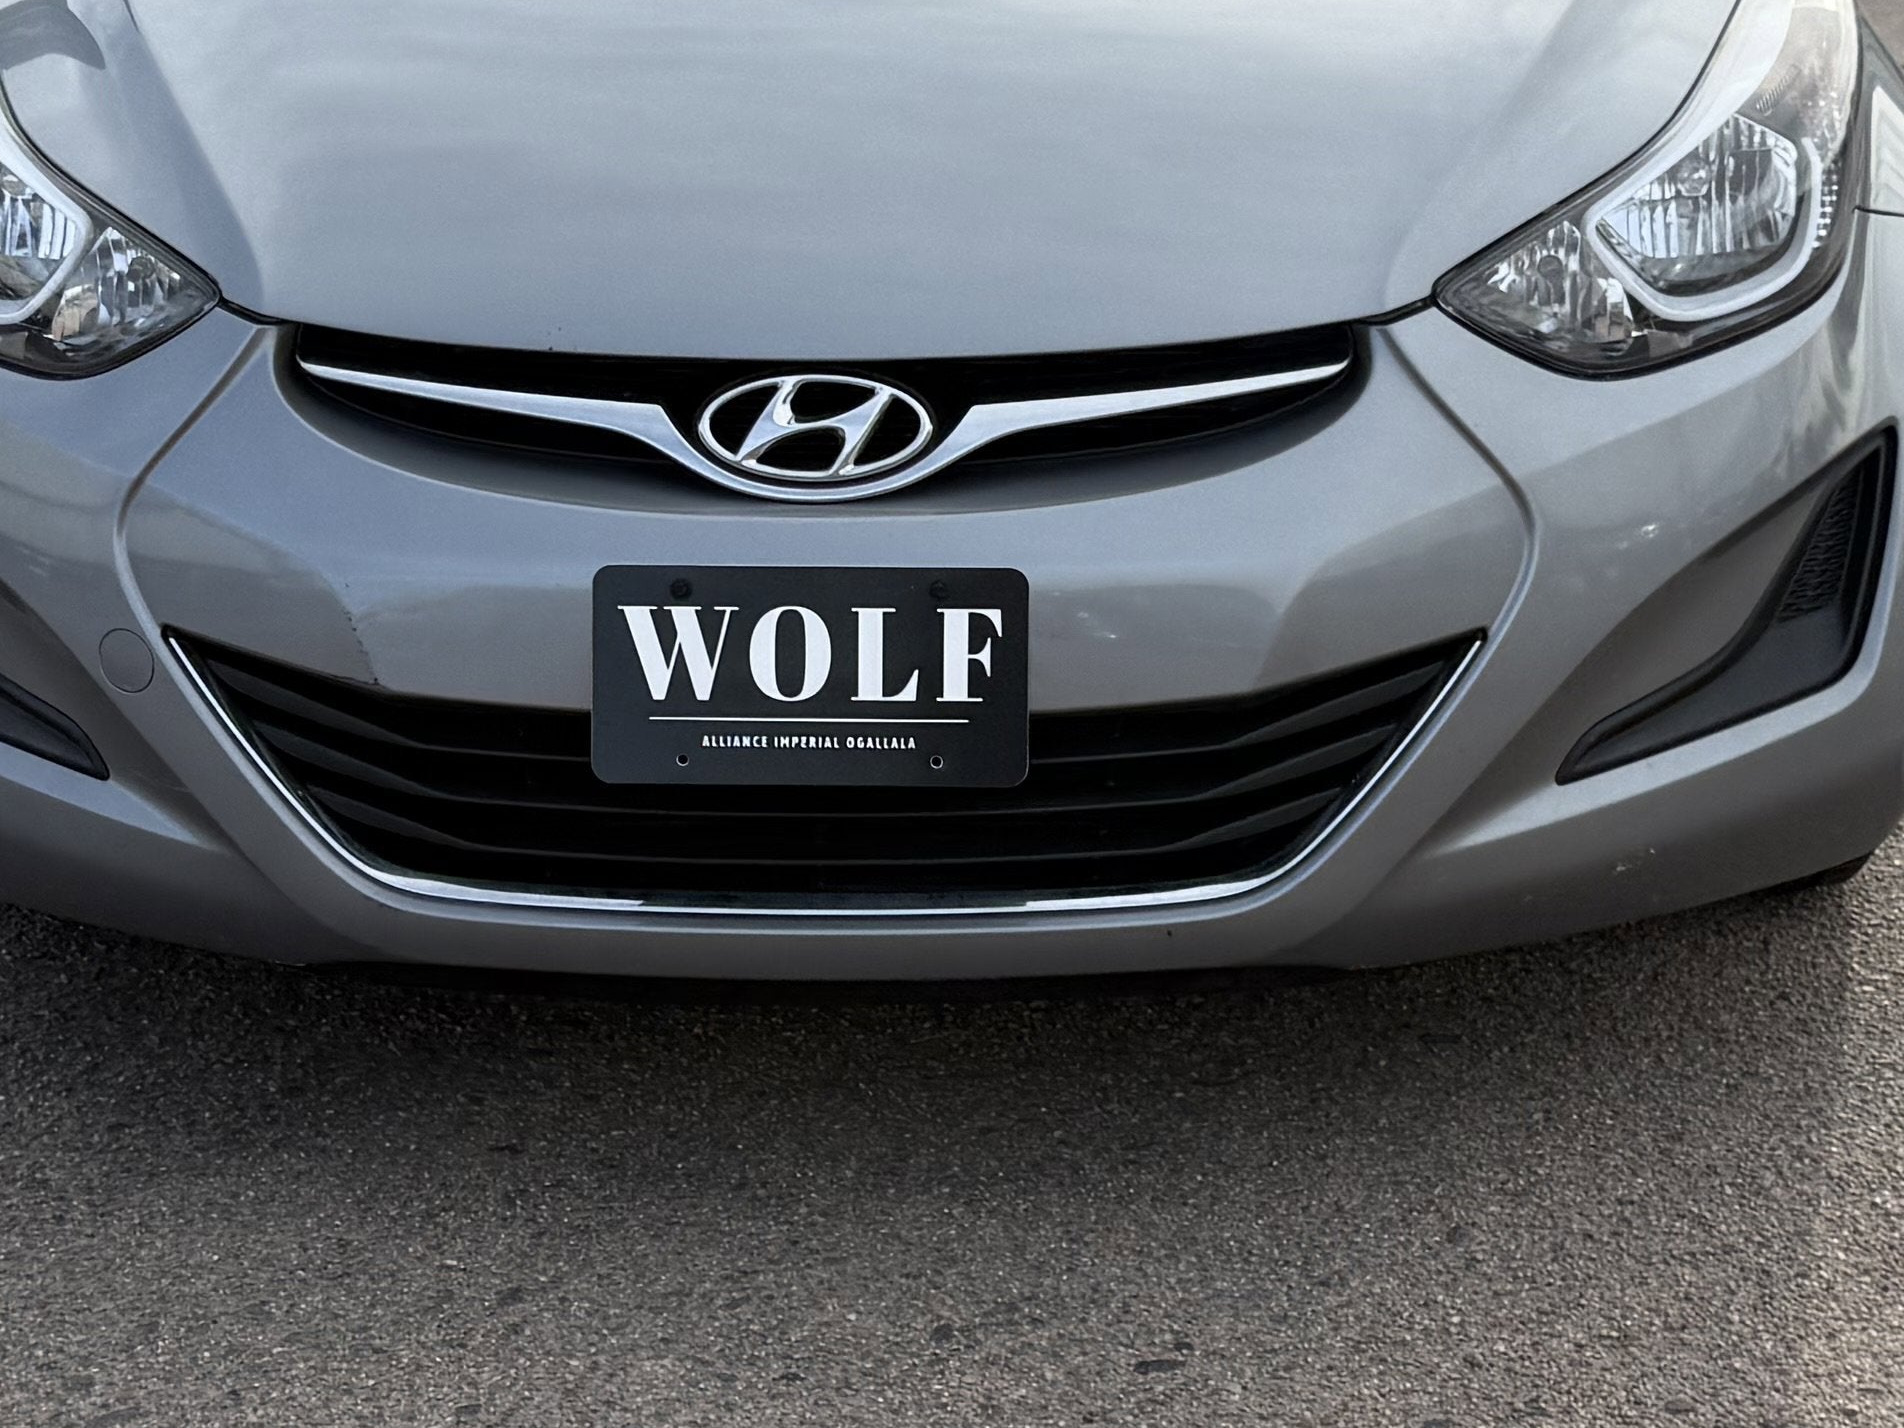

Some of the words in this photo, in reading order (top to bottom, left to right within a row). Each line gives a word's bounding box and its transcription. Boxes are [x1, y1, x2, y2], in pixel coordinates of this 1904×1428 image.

[617, 605, 1003, 702] WOLF
[701, 735, 769, 748] ALLIANCE
[774, 736, 840, 749] IMPERIAL
[845, 736, 917, 750] OGALLALA
